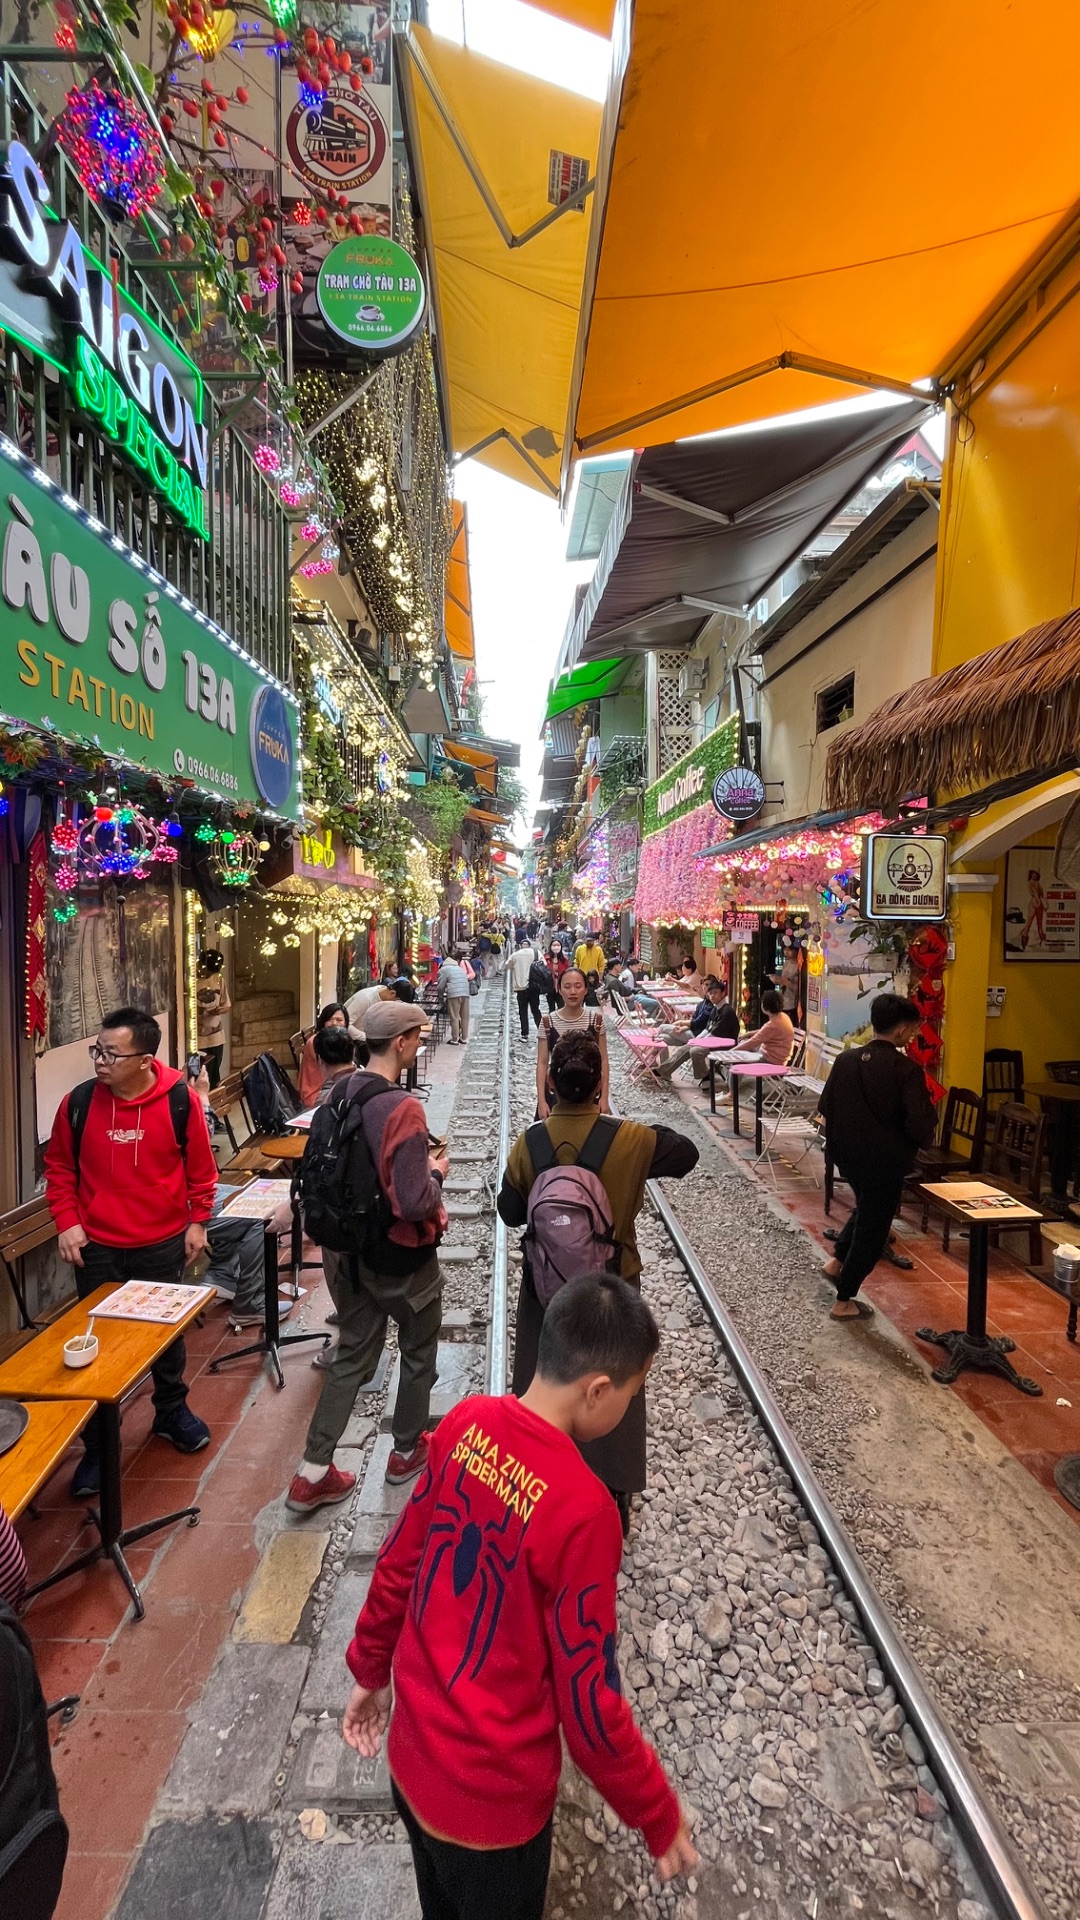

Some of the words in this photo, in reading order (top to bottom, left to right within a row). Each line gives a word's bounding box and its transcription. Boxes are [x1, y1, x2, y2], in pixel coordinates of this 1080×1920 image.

[319, 152, 356, 164] TRAIN
[316, 179, 340, 189] TRAIN
[341, 171, 372, 189] STATION
[346, 254, 394, 266] FRUKA
[324, 273, 350, 292] TRẠM
[352, 272, 372, 290] CHỜ
[374, 273, 394, 291] TÀU
[398, 277, 417, 292] 13A
[348, 293, 374, 301] TRAIN
[376, 294, 412, 303] STATION
[7, 140, 208, 490] SAIGON
[76, 335, 210, 543] SPECIAL
[108, 590, 167, 690] SỐ
[182, 650, 236, 735] 13A
[17, 639, 155, 741] STATION
[258, 730, 290, 766] FRUKA
[187, 756, 239, 791] 0966.06.6886
[674, 764, 707, 806] Coffee
[728, 787, 754, 797] Anna
[876, 893, 887, 905] GA
[889, 893, 911, 905] ĐÔNG
[912, 893, 939, 906] DƯƠNG
[736, 919, 759, 932] COFFEE
[462, 1423, 549, 1503] AMAZING
[451, 1441, 535, 1524] SPIDERMAN
